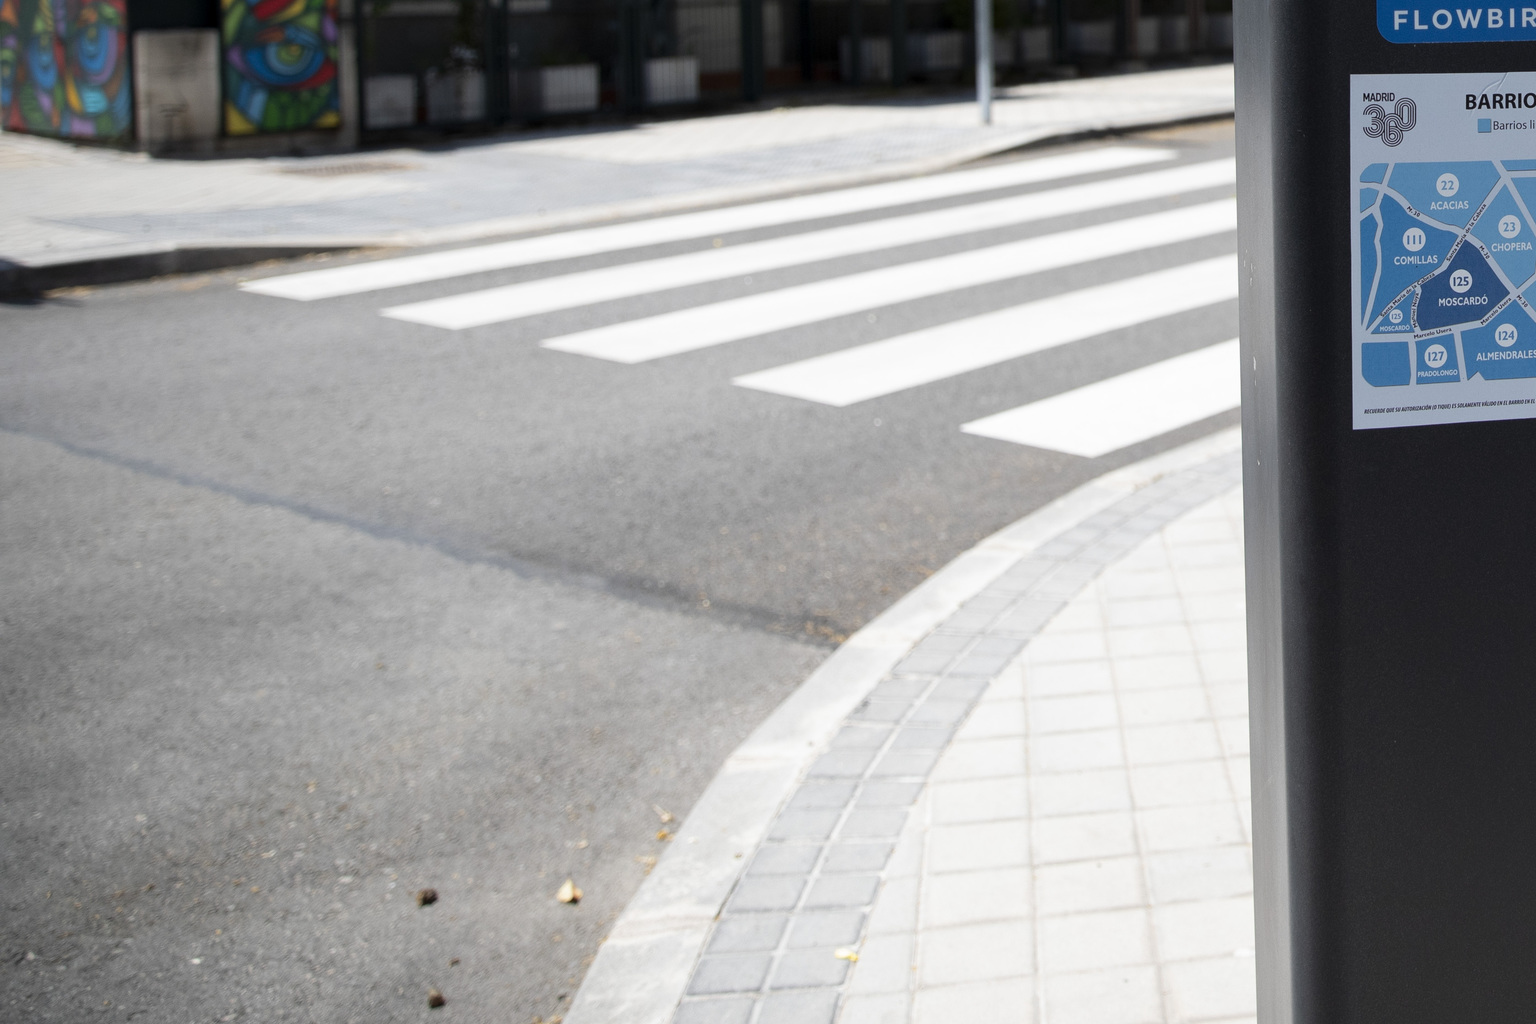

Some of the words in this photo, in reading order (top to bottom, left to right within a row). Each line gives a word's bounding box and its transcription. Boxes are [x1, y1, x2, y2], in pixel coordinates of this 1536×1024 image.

[1362, 92, 1396, 103] MADRID
[1362, 97, 1417, 147] 360
[1493, 120, 1528, 131] Barrios
[1440, 180, 1455, 191] 22
[1430, 200, 1469, 211] ACACIAS
[1446, 247, 1457, 262] Santa
[1472, 203, 1487, 222] Cabeza
[1503, 222, 1516, 232] 23
[1491, 242, 1533, 252] CHOPERA
[1394, 255, 1438, 265] COMILLAS
[1452, 276, 1469, 287] 125
[1438, 294, 1488, 307] MOSCARDÓ
[1391, 312, 1402, 320] 125
[1480, 309, 1498, 326] Marcelo
[1498, 330, 1515, 341] 124
[1427, 351, 1445, 362] 127
[1417, 369, 1458, 378] PRADOLONGO
